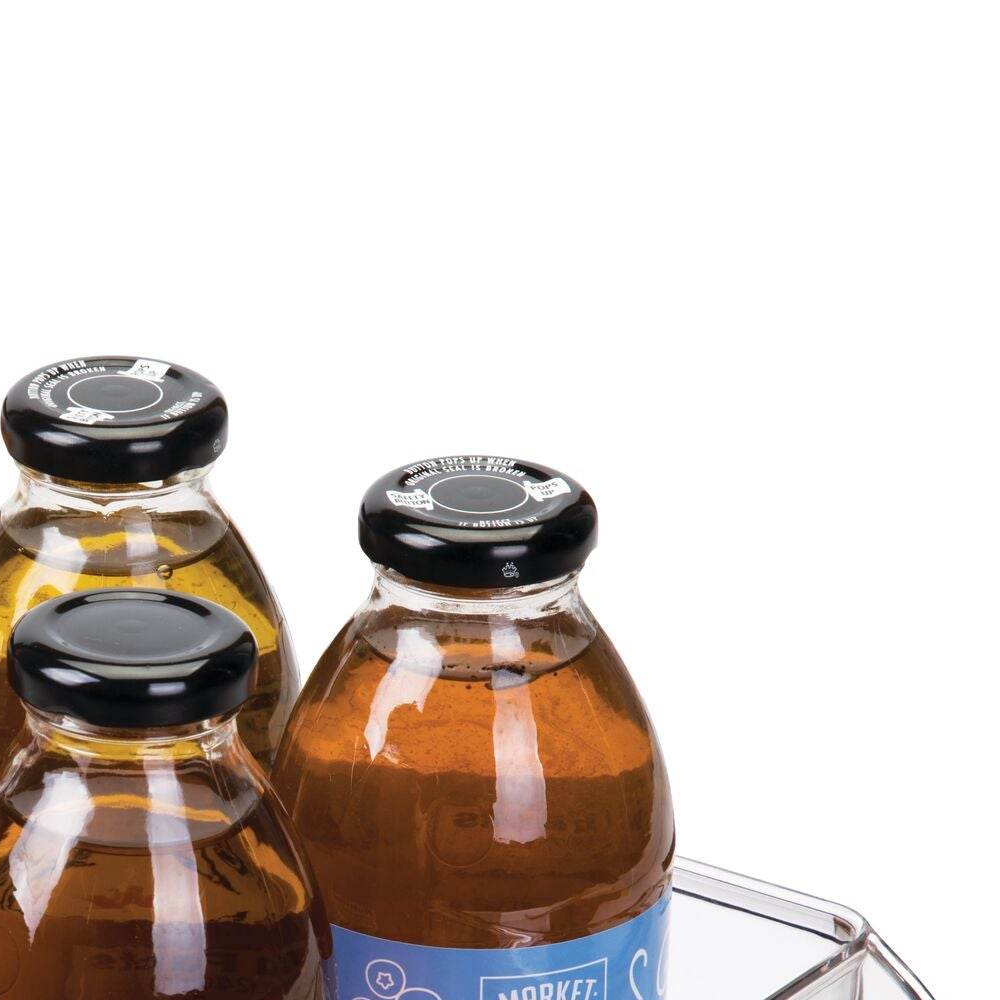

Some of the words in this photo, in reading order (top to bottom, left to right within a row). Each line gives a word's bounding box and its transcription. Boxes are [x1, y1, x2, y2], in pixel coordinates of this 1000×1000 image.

[59, 360, 87, 371] WHEN
[403, 460, 438, 475] BUTTON
[441, 456, 465, 465] POPS
[469, 456, 482, 464] UP
[487, 457, 517, 467] WHEN
[442, 465, 468, 473] SEAL
[486, 466, 527, 478] BROKEN
